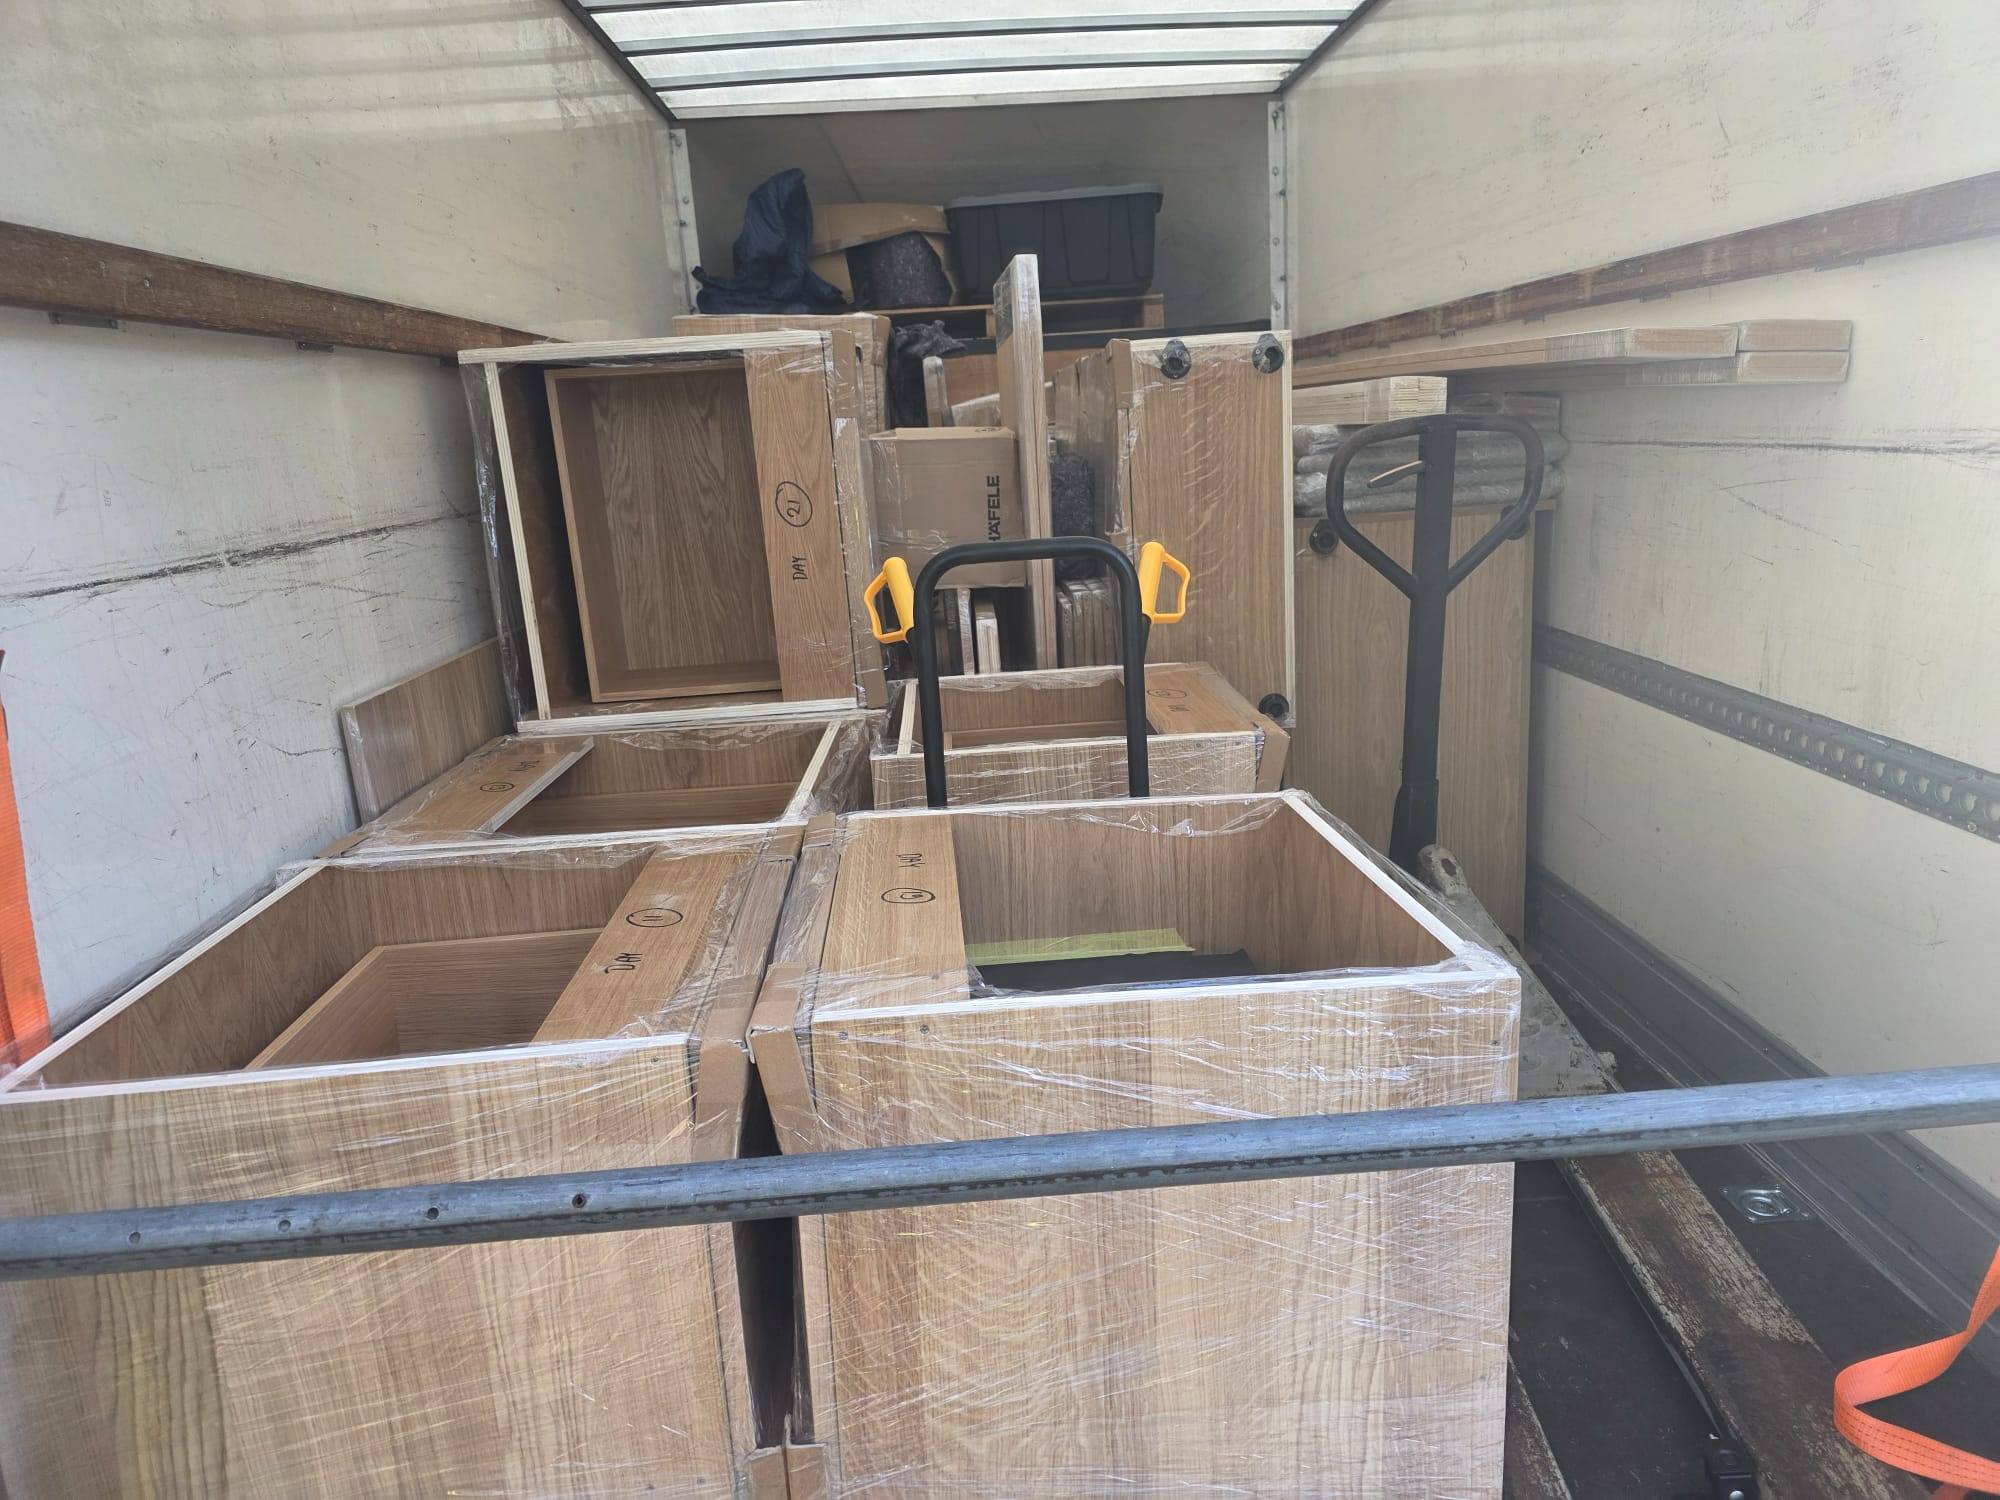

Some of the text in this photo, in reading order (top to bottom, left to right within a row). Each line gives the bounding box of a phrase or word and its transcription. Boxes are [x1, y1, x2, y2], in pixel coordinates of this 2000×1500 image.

[786, 499, 808, 580] DAY 21
[895, 853, 926, 868] DAY
[604, 952, 643, 974] DAY
